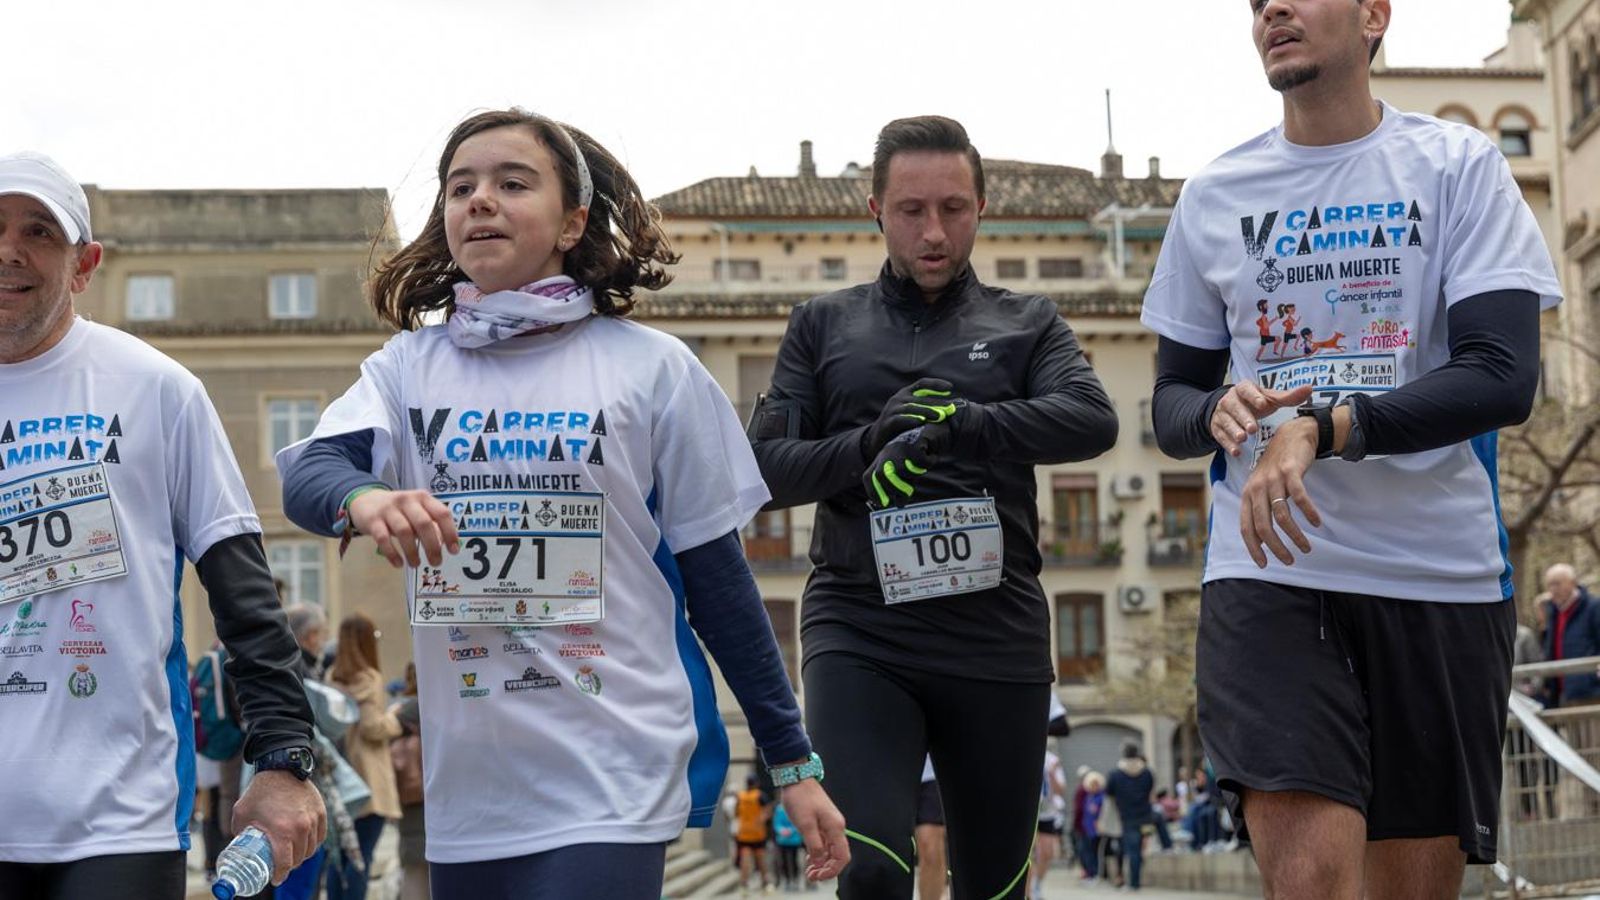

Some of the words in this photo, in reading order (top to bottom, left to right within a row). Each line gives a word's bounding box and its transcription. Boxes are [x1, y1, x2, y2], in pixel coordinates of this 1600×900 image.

[1240, 210, 1279, 260] V
[1286, 200, 1422, 231] CARRERA
[1275, 222, 1422, 257] CAMINATA
[1287, 264, 1334, 285] BUENA
[1340, 258, 1401, 279] MUERTE
[1370, 289, 1403, 301] infantil
[968, 352, 989, 361] ipso
[1361, 364, 1393, 375] BUENA
[1361, 375, 1393, 386] MUERTE
[408, 407, 451, 464] V
[458, 408, 607, 436] CARRERA
[446, 434, 605, 466] CAMINATA
[69, 483, 105, 499] MUERTE
[460, 474, 514, 491] BUENA
[519, 474, 581, 491] MUERTE
[453, 500, 530, 515] CARRERA
[561, 504, 599, 516] BUENA
[561, 518, 599, 530] MUERTE
[875, 516, 891, 536] V
[895, 507, 950, 523] CARRERA
[893, 518, 951, 535] CAMINATA
[0, 510, 73, 564] 370
[911, 531, 972, 567] 100
[462, 537, 547, 581] 371
[59, 647, 107, 655] VICTORIA
[559, 649, 606, 657] VICTORIA
